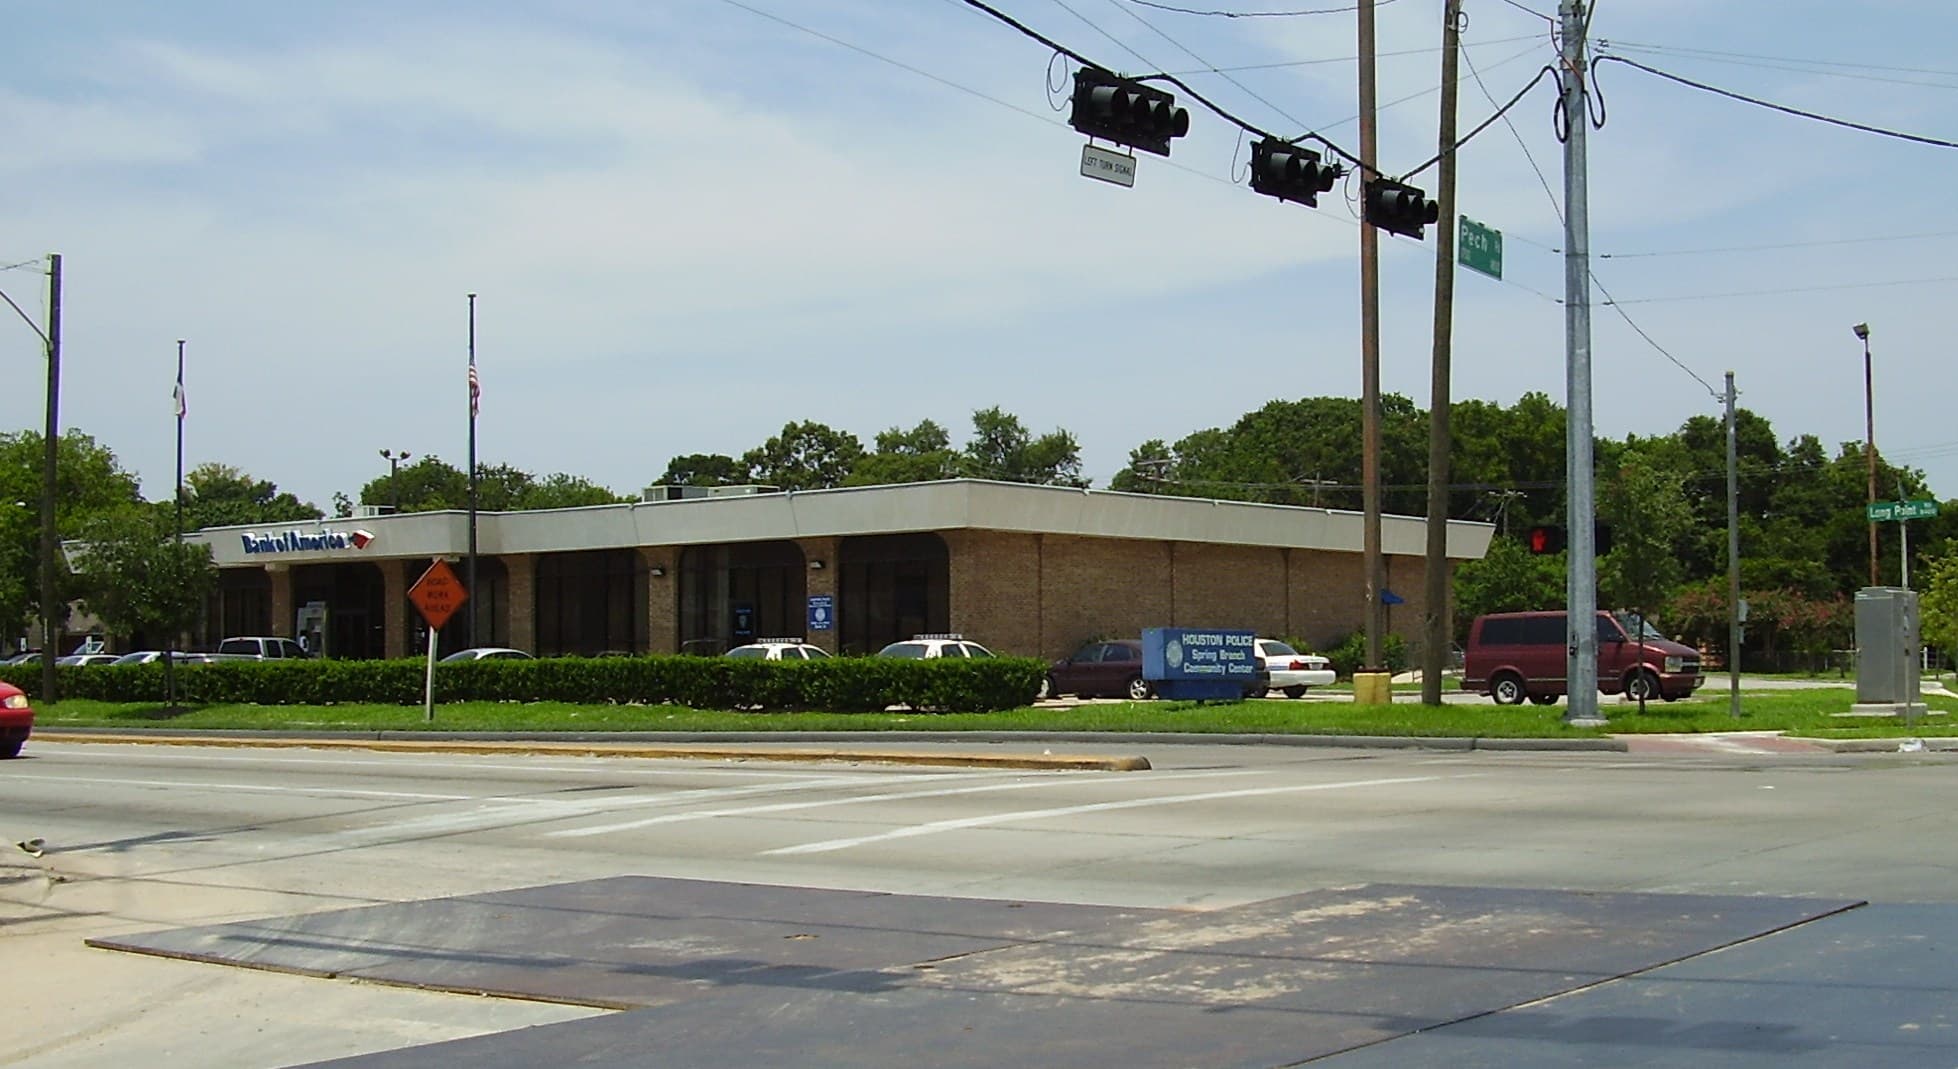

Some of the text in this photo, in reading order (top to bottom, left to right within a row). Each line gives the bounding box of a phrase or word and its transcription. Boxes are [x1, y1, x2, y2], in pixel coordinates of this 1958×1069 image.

[1460, 224, 1488, 254] Pech
[1870, 507, 1892, 520] Long
[1894, 504, 1917, 516] Point
[241, 531, 277, 554] Bank
[289, 528, 350, 551] America
[1182, 633, 1254, 647] HOUSTON POLICE
[1191, 649, 1246, 662] Spring Branch
[1183, 662, 1254, 675] Community Center
